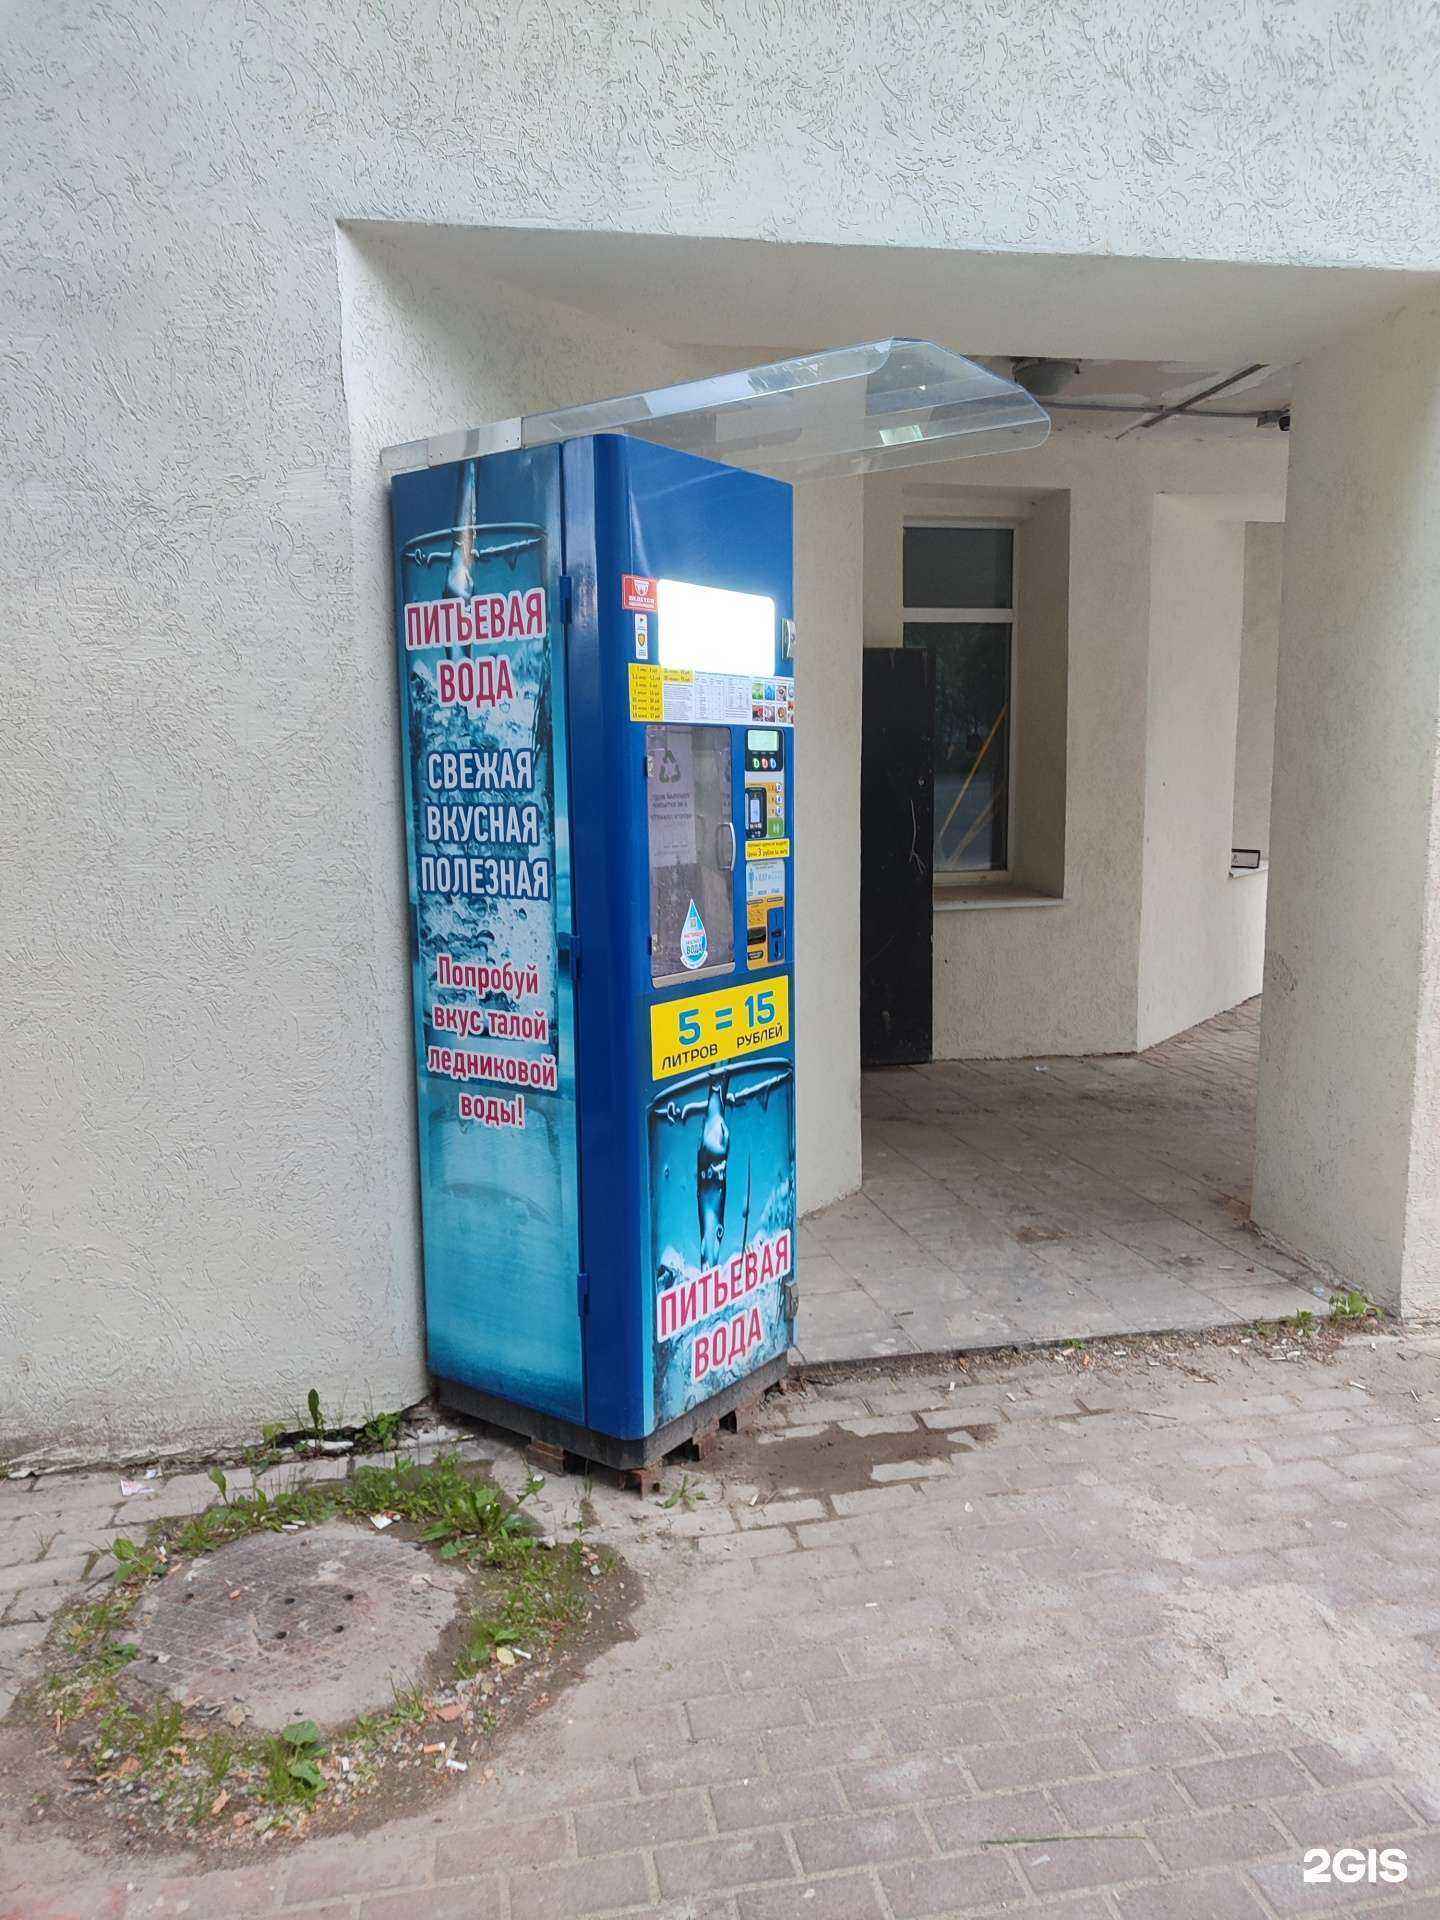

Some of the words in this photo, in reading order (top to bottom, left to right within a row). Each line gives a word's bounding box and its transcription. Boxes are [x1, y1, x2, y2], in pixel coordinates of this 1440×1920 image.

[406, 592, 545, 647] ПИТЬЕВАЯ
[438, 660, 513, 707] ВОДА
[427, 751, 534, 789] СВЕЖАЯ
[426, 805, 538, 844] ВКУСНАЯ
[421, 857, 549, 897] ПОЛЕЗНАЯ
[438, 956, 539, 999] Попробуй
[433, 1007, 481, 1036] вкус
[488, 1011, 547, 1041] талой
[678, 1008, 701, 1046] 5
[715, 1007, 733, 1031] =
[744, 990, 776, 1028] 15
[661, 1043, 719, 1070] ЛИТРОВ
[736, 1022, 783, 1049] РУБЛЕЙ
[429, 1048, 556, 1088] ледниковой
[460, 1095, 525, 1126] воды!
[660, 1233, 789, 1338] ПИТЬЕВАЯ
[694, 1306, 763, 1379] ВОДА
